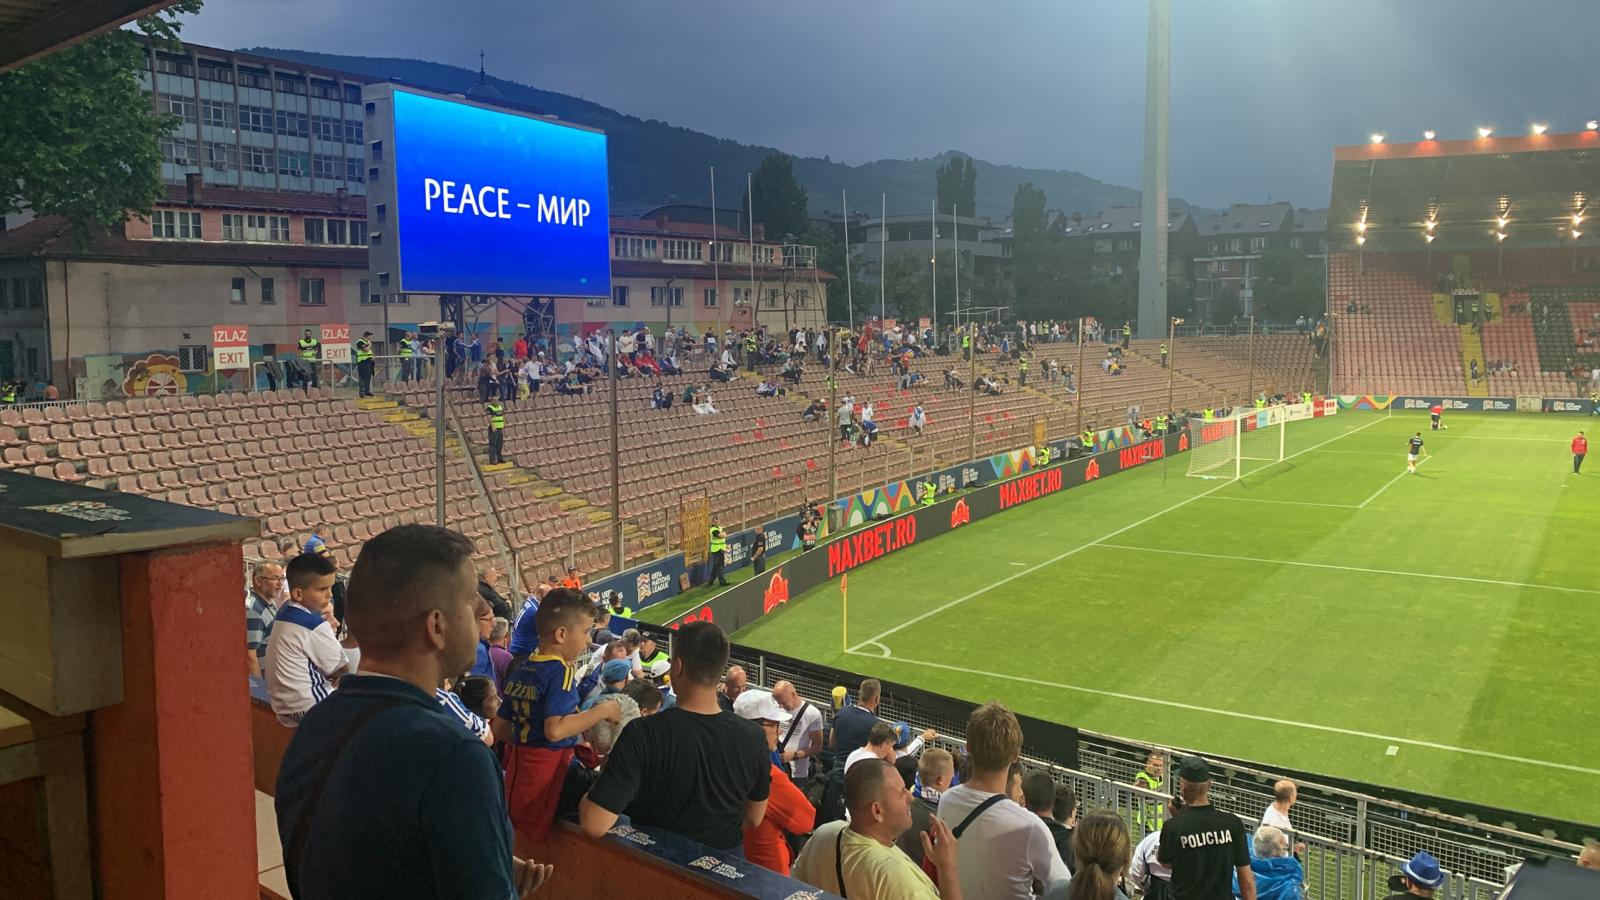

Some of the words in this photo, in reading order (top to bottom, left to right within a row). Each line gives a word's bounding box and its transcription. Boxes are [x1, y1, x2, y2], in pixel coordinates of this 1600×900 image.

[424, 178, 511, 219] PEACE
[537, 193, 591, 227] МИР
[213, 330, 248, 342] IZLAZ
[321, 328, 349, 340] IZLAZ
[219, 352, 244, 364] EXIT
[326, 348, 347, 360] EXIT
[1000, 468, 1062, 509] MAXBET.RO
[828, 515, 916, 577] MAXBET.RO
[651, 571, 662, 580] UEFA
[652, 574, 671, 585] NATIONS
[652, 582, 669, 593] LEAGUE
[1180, 829, 1232, 848] POLICIJA
